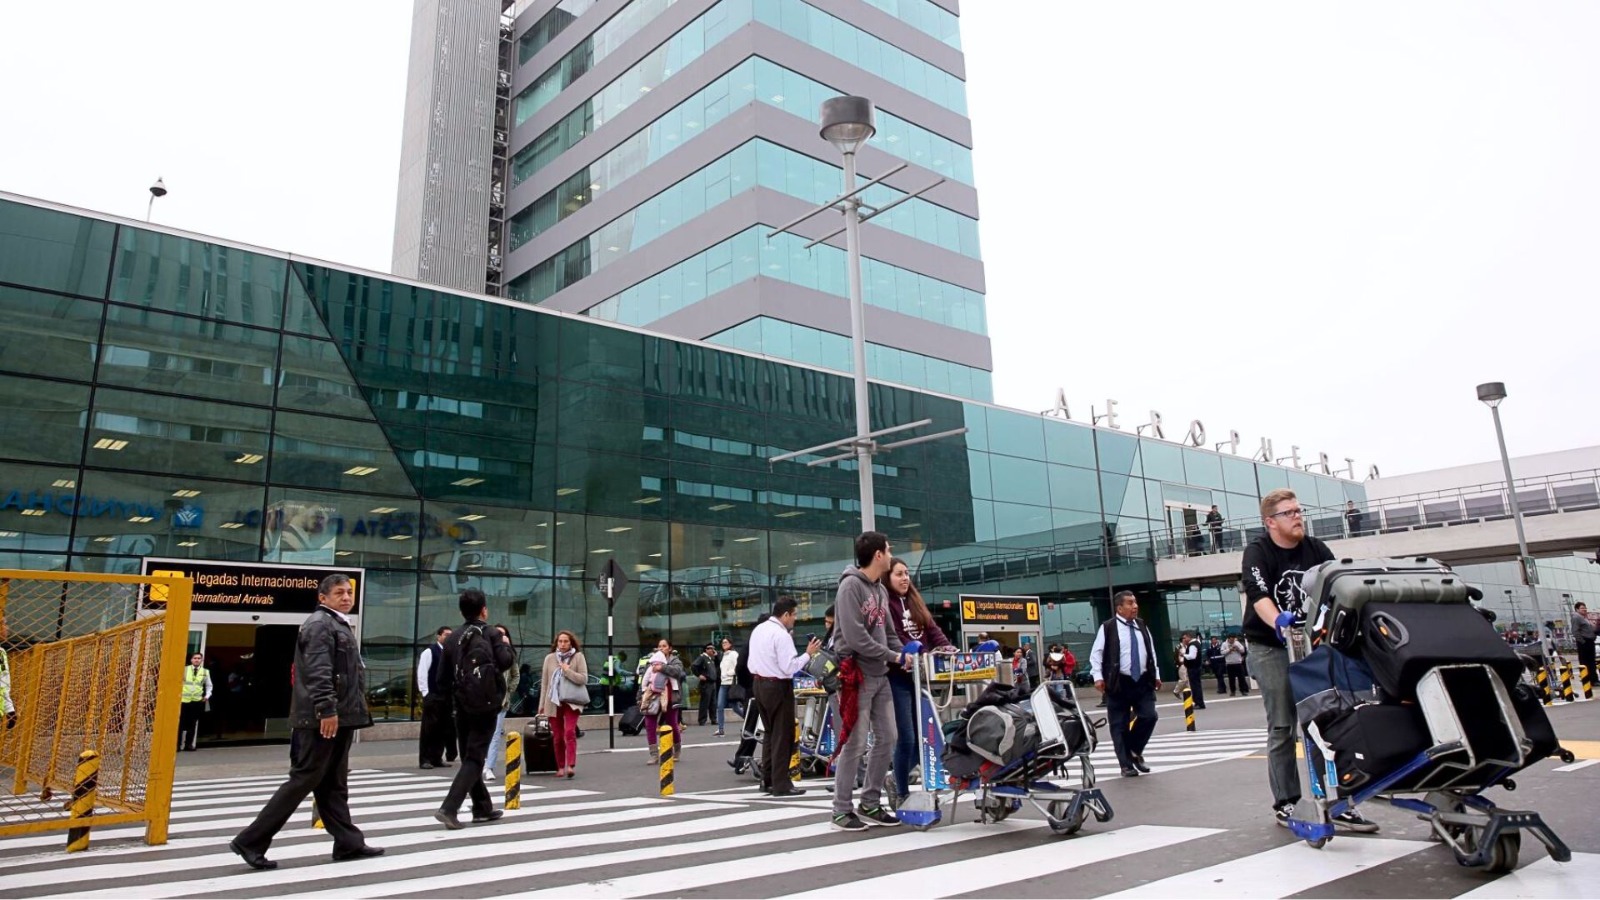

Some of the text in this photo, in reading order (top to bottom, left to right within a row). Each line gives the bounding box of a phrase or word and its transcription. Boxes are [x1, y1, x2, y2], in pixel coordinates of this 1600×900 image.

[1053, 387, 1380, 480] AEROPUERTO
[241, 573, 319, 589] Internacionales
[192, 593, 274, 605] nternational Arrivals
[976, 601, 1024, 611] Llegadas Internacionales
[1029, 604, 1036, 619] 4
